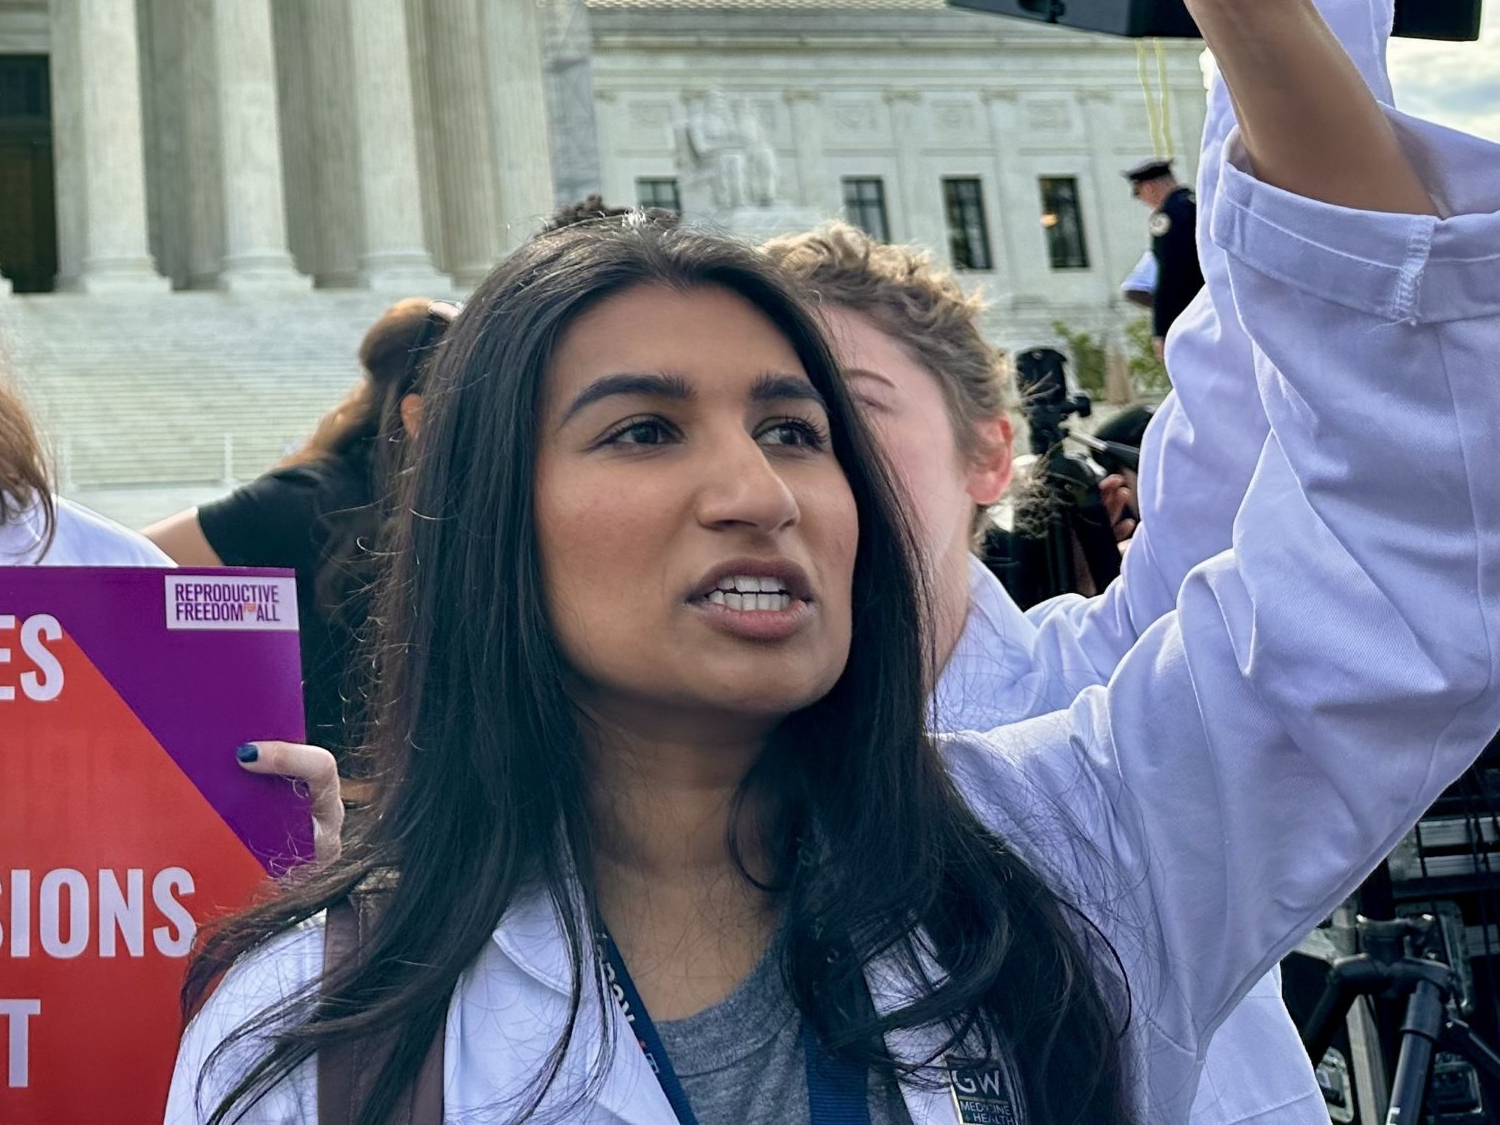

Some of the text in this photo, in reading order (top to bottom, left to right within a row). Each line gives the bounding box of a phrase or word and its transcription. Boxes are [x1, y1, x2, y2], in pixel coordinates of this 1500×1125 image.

[175, 583, 279, 603] REPRODUCTIVE
[176, 602, 244, 621] FREEDOM
[256, 604, 280, 622] ALL
[950, 1069, 1000, 1096] GW
